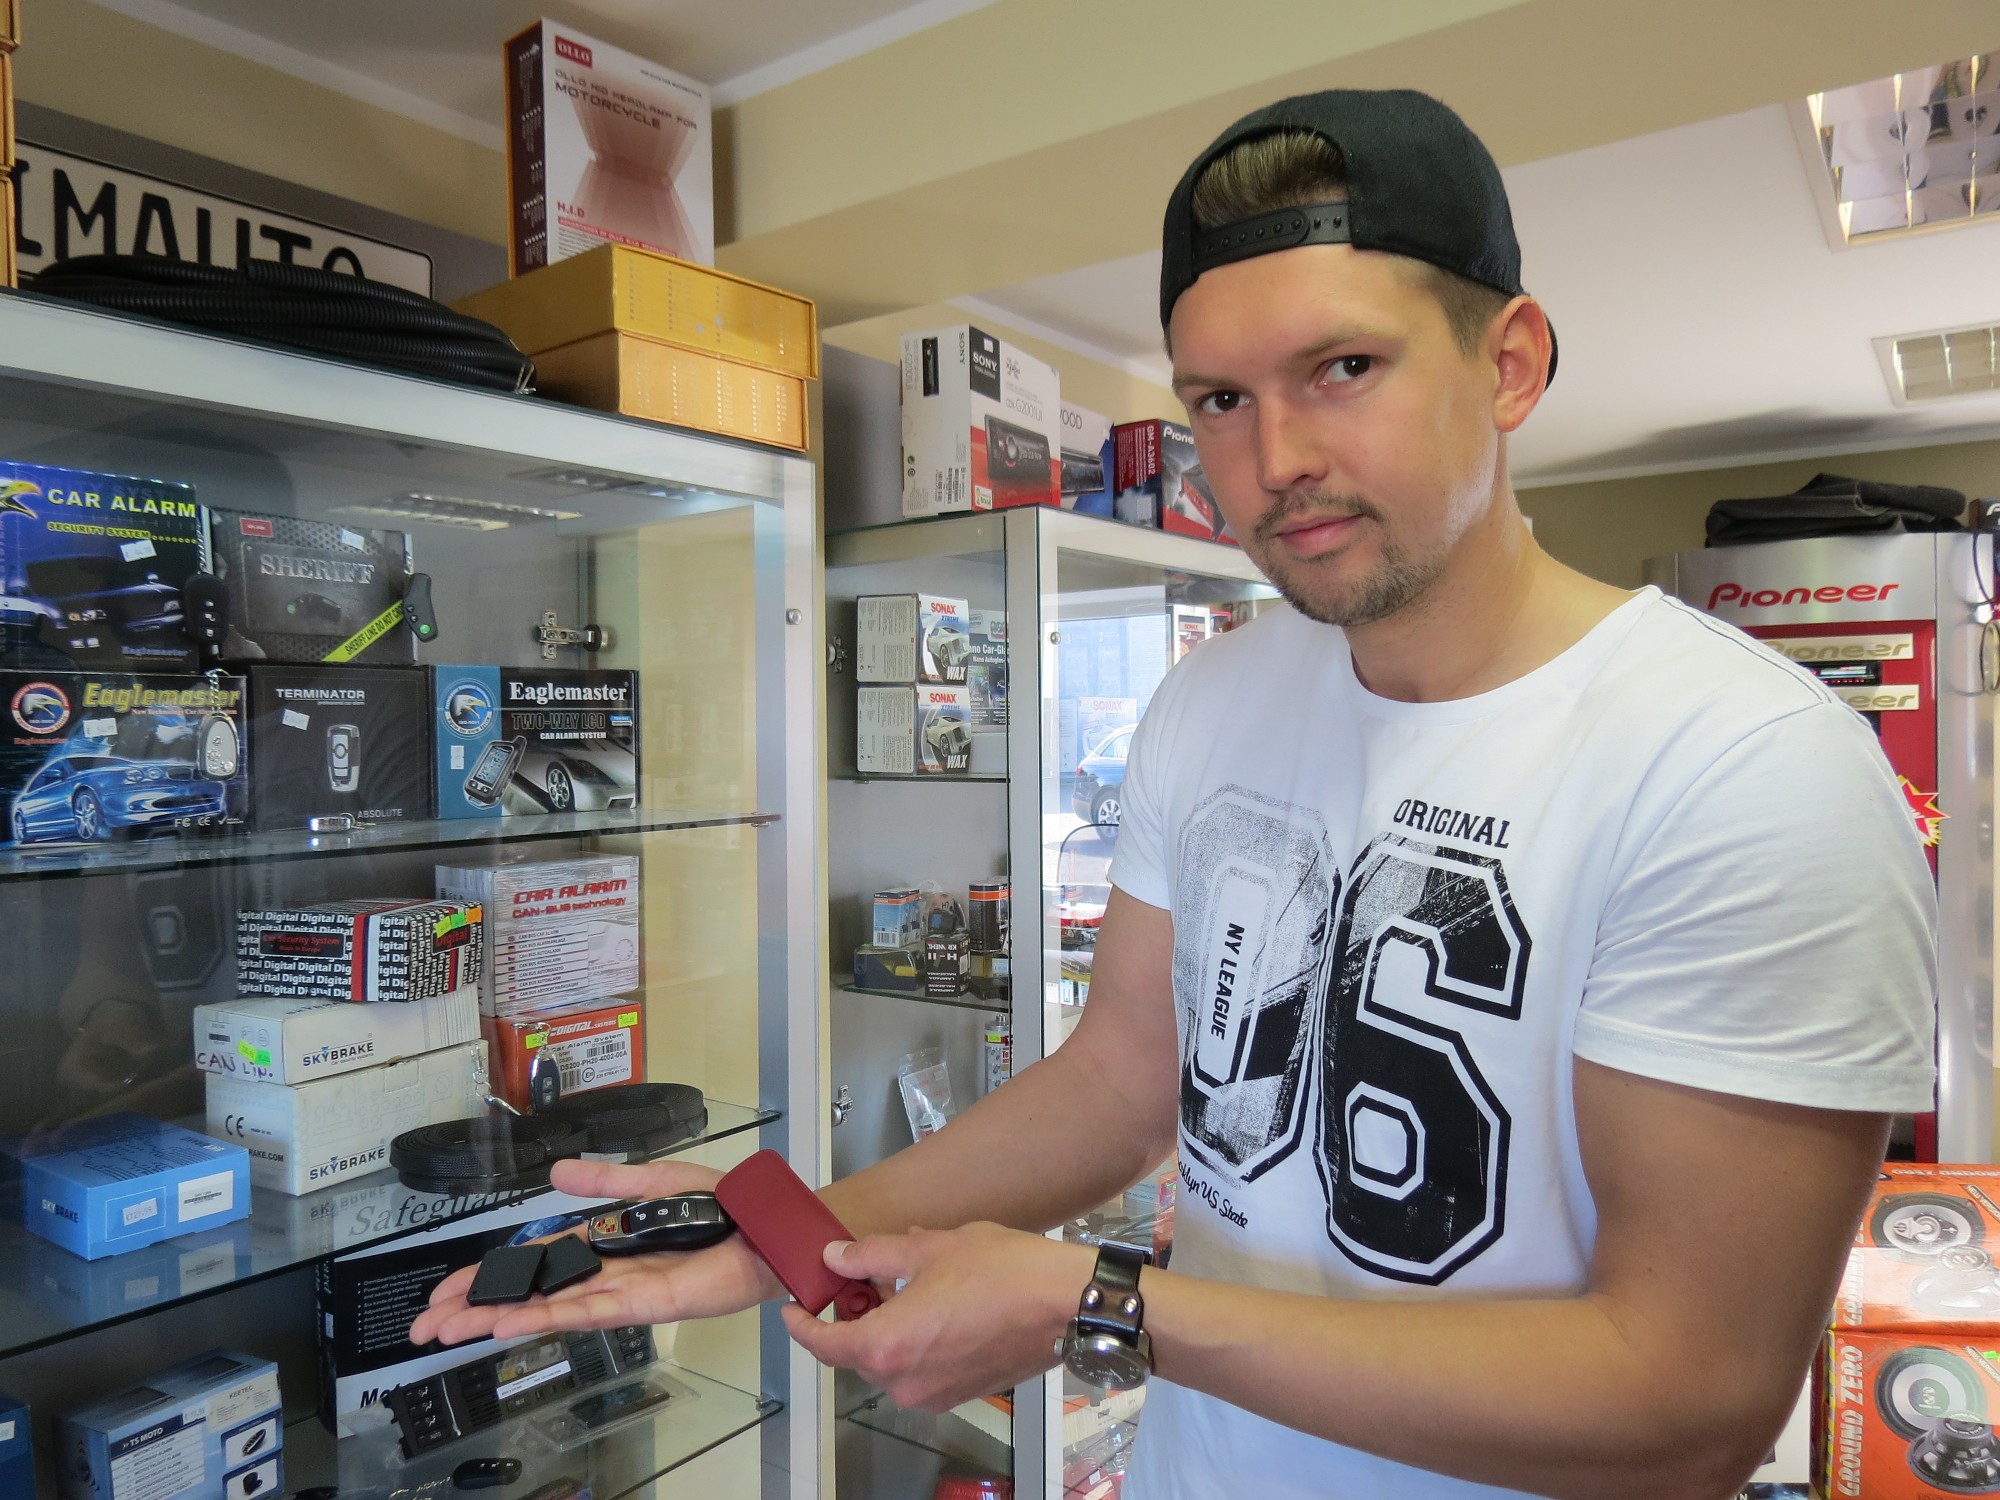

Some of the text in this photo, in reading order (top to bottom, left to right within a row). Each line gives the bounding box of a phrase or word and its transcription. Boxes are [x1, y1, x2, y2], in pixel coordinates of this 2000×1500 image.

[558, 42, 590, 62] OLLO
[555, 69, 697, 130] OLLO HID HEADLAMP FOR
[555, 81, 661, 130] MOTORCYCLE
[557, 202, 585, 218] H.I.D
[973, 352, 998, 372] SONY
[1146, 425, 1155, 475] GM-A3602
[48, 489, 101, 508] CAR
[111, 496, 196, 518] ALARM
[47, 522, 105, 535] SECURITY
[260, 553, 375, 584] SHERIFF
[1707, 583, 1899, 610] Pioneer
[931, 602, 957, 615] SONAX
[344, 611, 396, 655] SHERIFF LINE DO NOT
[947, 666, 966, 681] WAX
[276, 688, 365, 699] TERMINATOR
[509, 682, 627, 705] Eaglemaster
[930, 693, 957, 704] SONAX
[1093, 701, 1123, 711] SONAX
[512, 713, 581, 730] TWO-WAY
[581, 713, 606, 729] LCD
[540, 732, 606, 740] CAR ALARM SYSTEM
[947, 754, 968, 769] WAX
[357, 808, 403, 819] ABSOLUTE
[1394, 799, 1510, 849] ORIGINAL
[514, 879, 627, 905] CAR ALARM
[265, 911, 298, 923] Digital
[300, 913, 334, 925] Digital
[512, 897, 627, 919] CAN-BUS technology
[264, 961, 296, 972] Digital
[298, 962, 331, 973] Digital
[249, 971, 352, 987] Digital Digital Digital
[1209, 922, 1245, 1041] NY LEAGUE
[264, 985, 295, 996] Digital
[568, 1040, 592, 1048] Alarm
[593, 1033, 624, 1042] System
[197, 1052, 236, 1073] CAN
[303, 1042, 374, 1067] SKYBRAKE
[225, 1114, 244, 1138] CE
[310, 1148, 385, 1180] SKYBRAKE
[41, 1199, 78, 1223] SKYBRAKE
[1201, 1181, 1220, 1209] US
[1219, 1198, 1249, 1229] State
[229, 1385, 253, 1399] KEETEC
[1837, 1345, 1864, 1497] GROUND ZERO
[129, 1427, 164, 1446] TS MOTO
